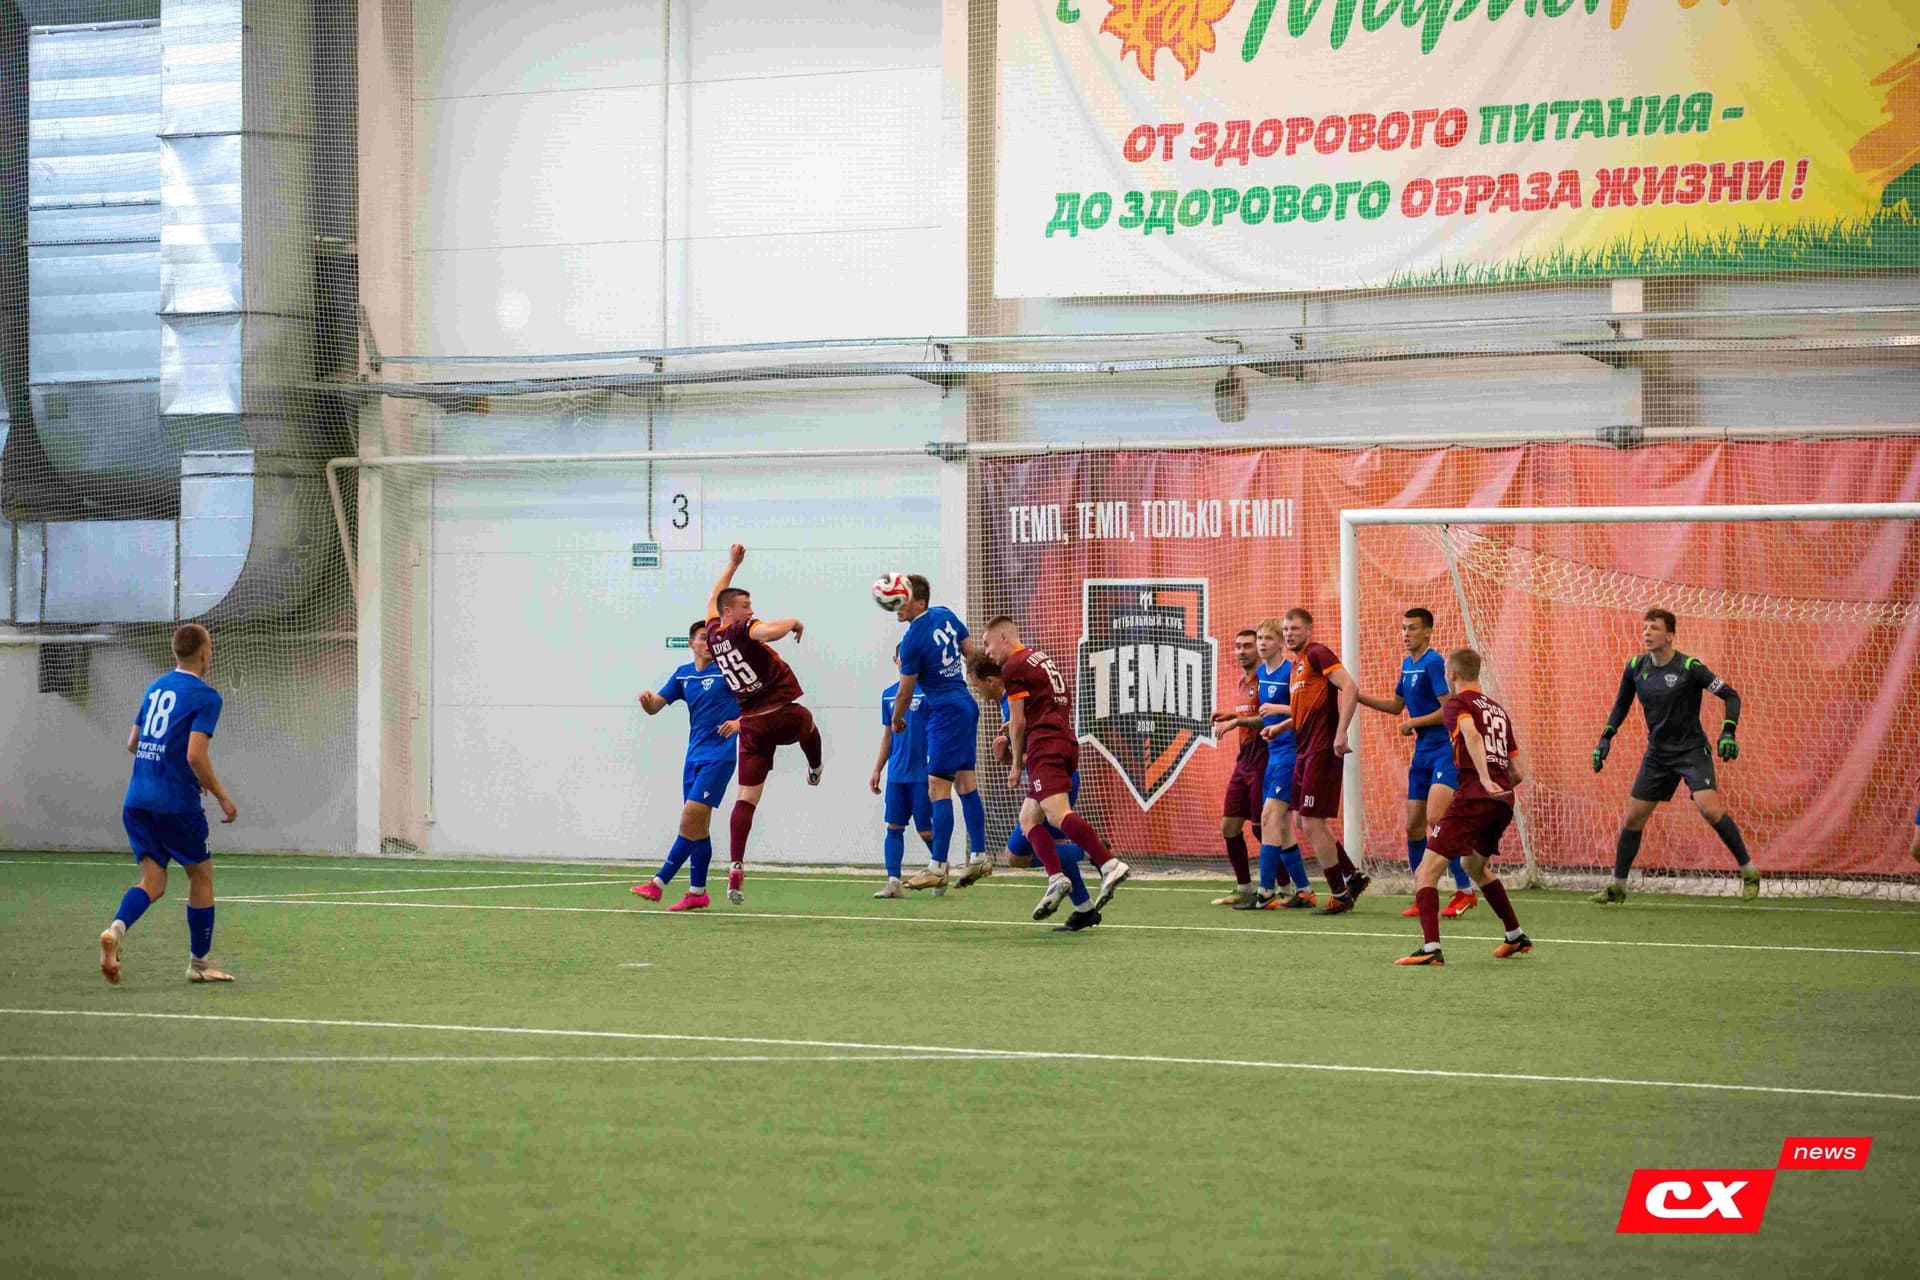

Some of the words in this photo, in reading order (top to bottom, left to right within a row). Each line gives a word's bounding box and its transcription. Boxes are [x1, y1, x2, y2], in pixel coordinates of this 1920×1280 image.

[1123, 123, 1184, 163] ОТ
[1189, 108, 1468, 167] ЗДОРОВОГО
[1479, 92, 1713, 145] ПИТАНИЯ
[1045, 192, 1113, 238] ДО
[1118, 180, 1391, 236] ЗДОРОВОГО
[1401, 171, 1582, 218] ОБРАЗА
[672, 494, 690, 530] 3
[1009, 504, 1070, 545] ТЕМП,
[1076, 501, 1135, 543] ТЕМП,
[1141, 499, 1222, 538] ТОЛЬКО
[1228, 498, 1293, 538] ТЕМП!
[933, 621, 961, 667] 21
[1165, 616, 1183, 630] КЛУБ
[1040, 659, 1066, 694] 15
[1088, 644, 1203, 721] ТЕМП
[142, 688, 177, 739] 18
[1482, 709, 1508, 758] 33
[1303, 795, 1315, 808] 90
